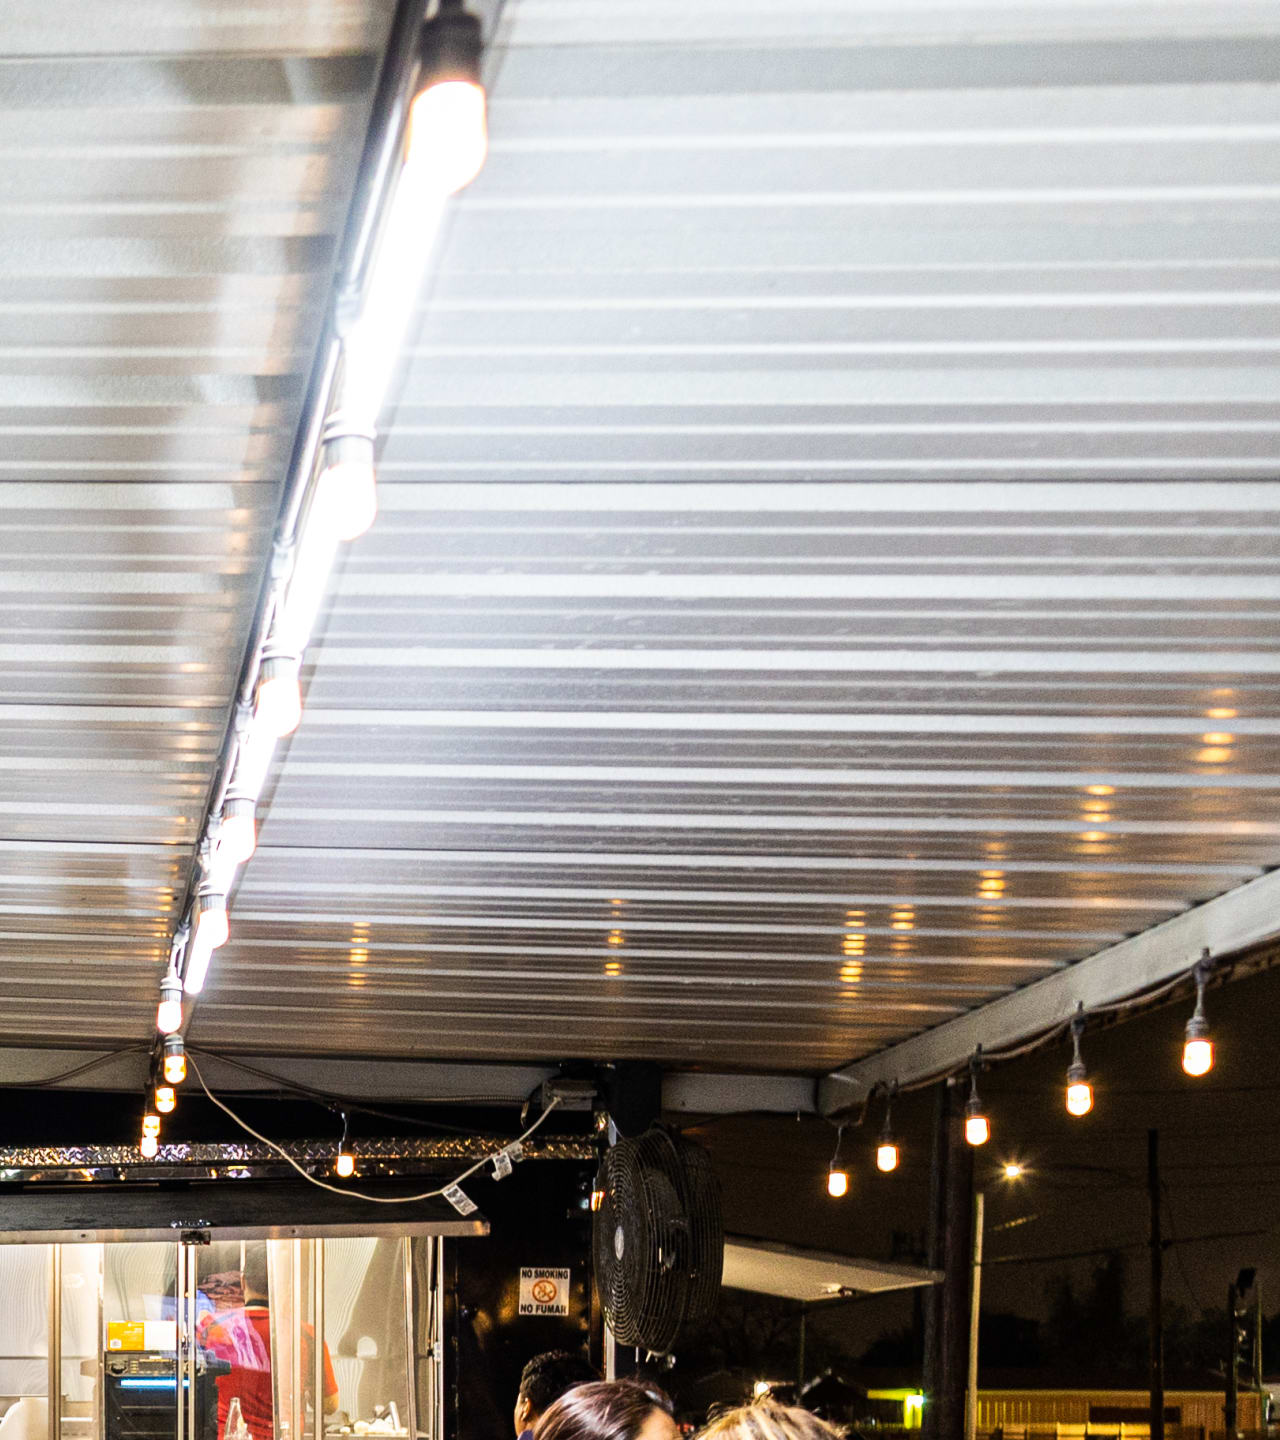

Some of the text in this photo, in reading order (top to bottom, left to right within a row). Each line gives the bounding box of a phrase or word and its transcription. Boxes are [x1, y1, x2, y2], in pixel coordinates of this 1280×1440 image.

[521, 1268, 569, 1280] NO SMOKING
[520, 1303, 567, 1314] NO FUMAR
